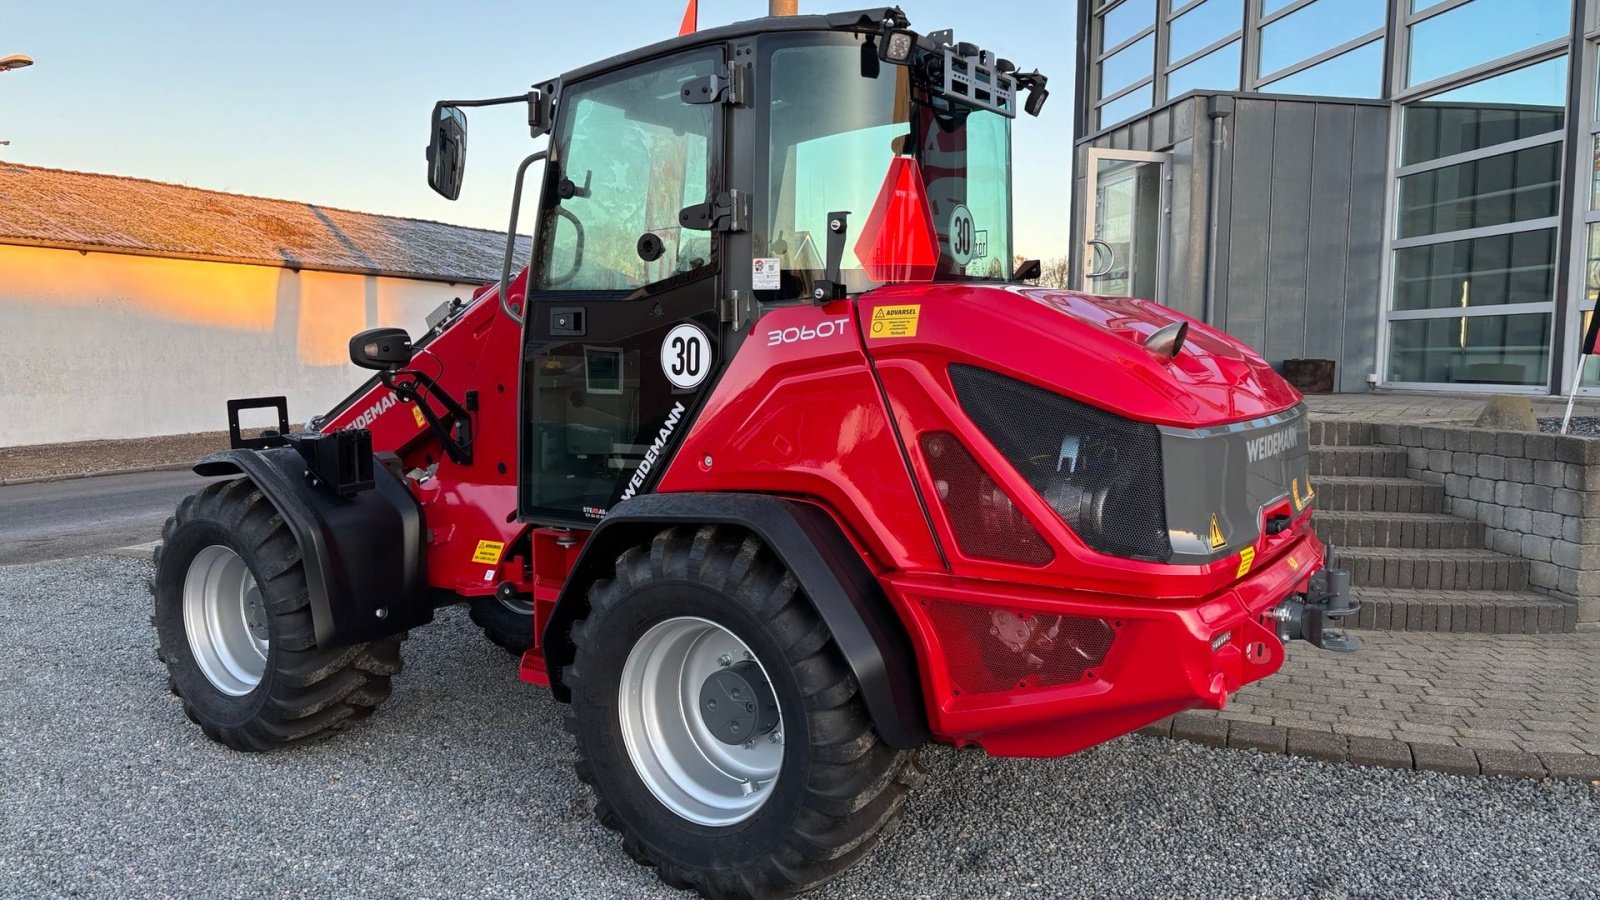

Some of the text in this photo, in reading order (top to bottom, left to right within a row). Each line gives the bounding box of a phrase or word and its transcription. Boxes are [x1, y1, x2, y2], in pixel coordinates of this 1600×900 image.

[954, 216, 970, 256] 30
[767, 318, 850, 347] 3060T
[671, 336, 701, 377] 30
[620, 401, 686, 501] WEIDEMANN
[1246, 424, 1298, 464] WEIDEMANN
